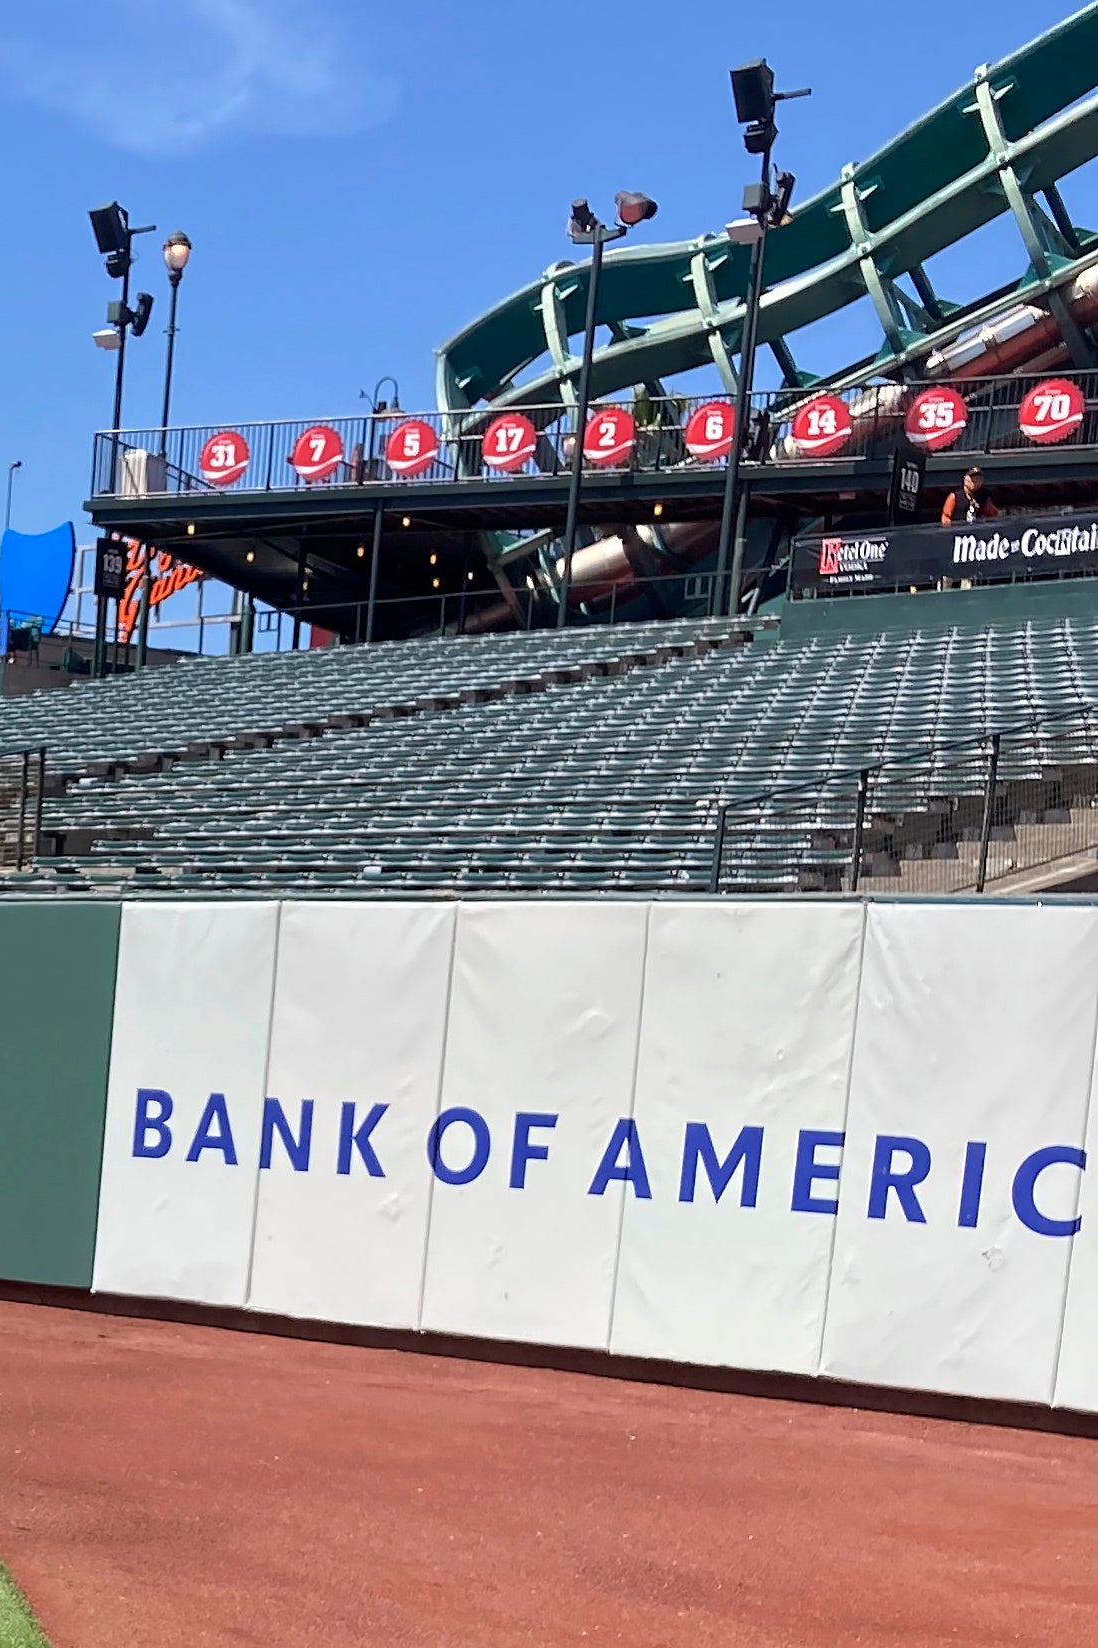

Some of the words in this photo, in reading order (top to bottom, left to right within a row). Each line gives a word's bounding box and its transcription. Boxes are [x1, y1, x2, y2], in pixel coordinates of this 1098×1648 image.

[918, 402, 956, 428] 35
[1034, 395, 1071, 421] 70
[598, 422, 616, 447] 2
[705, 416, 723, 440] 6
[807, 410, 838, 436] 14
[309, 439, 326, 462] 7
[403, 433, 420, 457] 5
[495, 427, 524, 452] 17
[210, 443, 236, 467] 31
[901, 467, 919, 493] 140
[953, 532, 1010, 564] Made
[103, 553, 122, 574] 139
[132, 1087, 390, 1178] BANK
[427, 1106, 559, 1189] OF
[587, 1117, 1088, 1237] AMERIC
